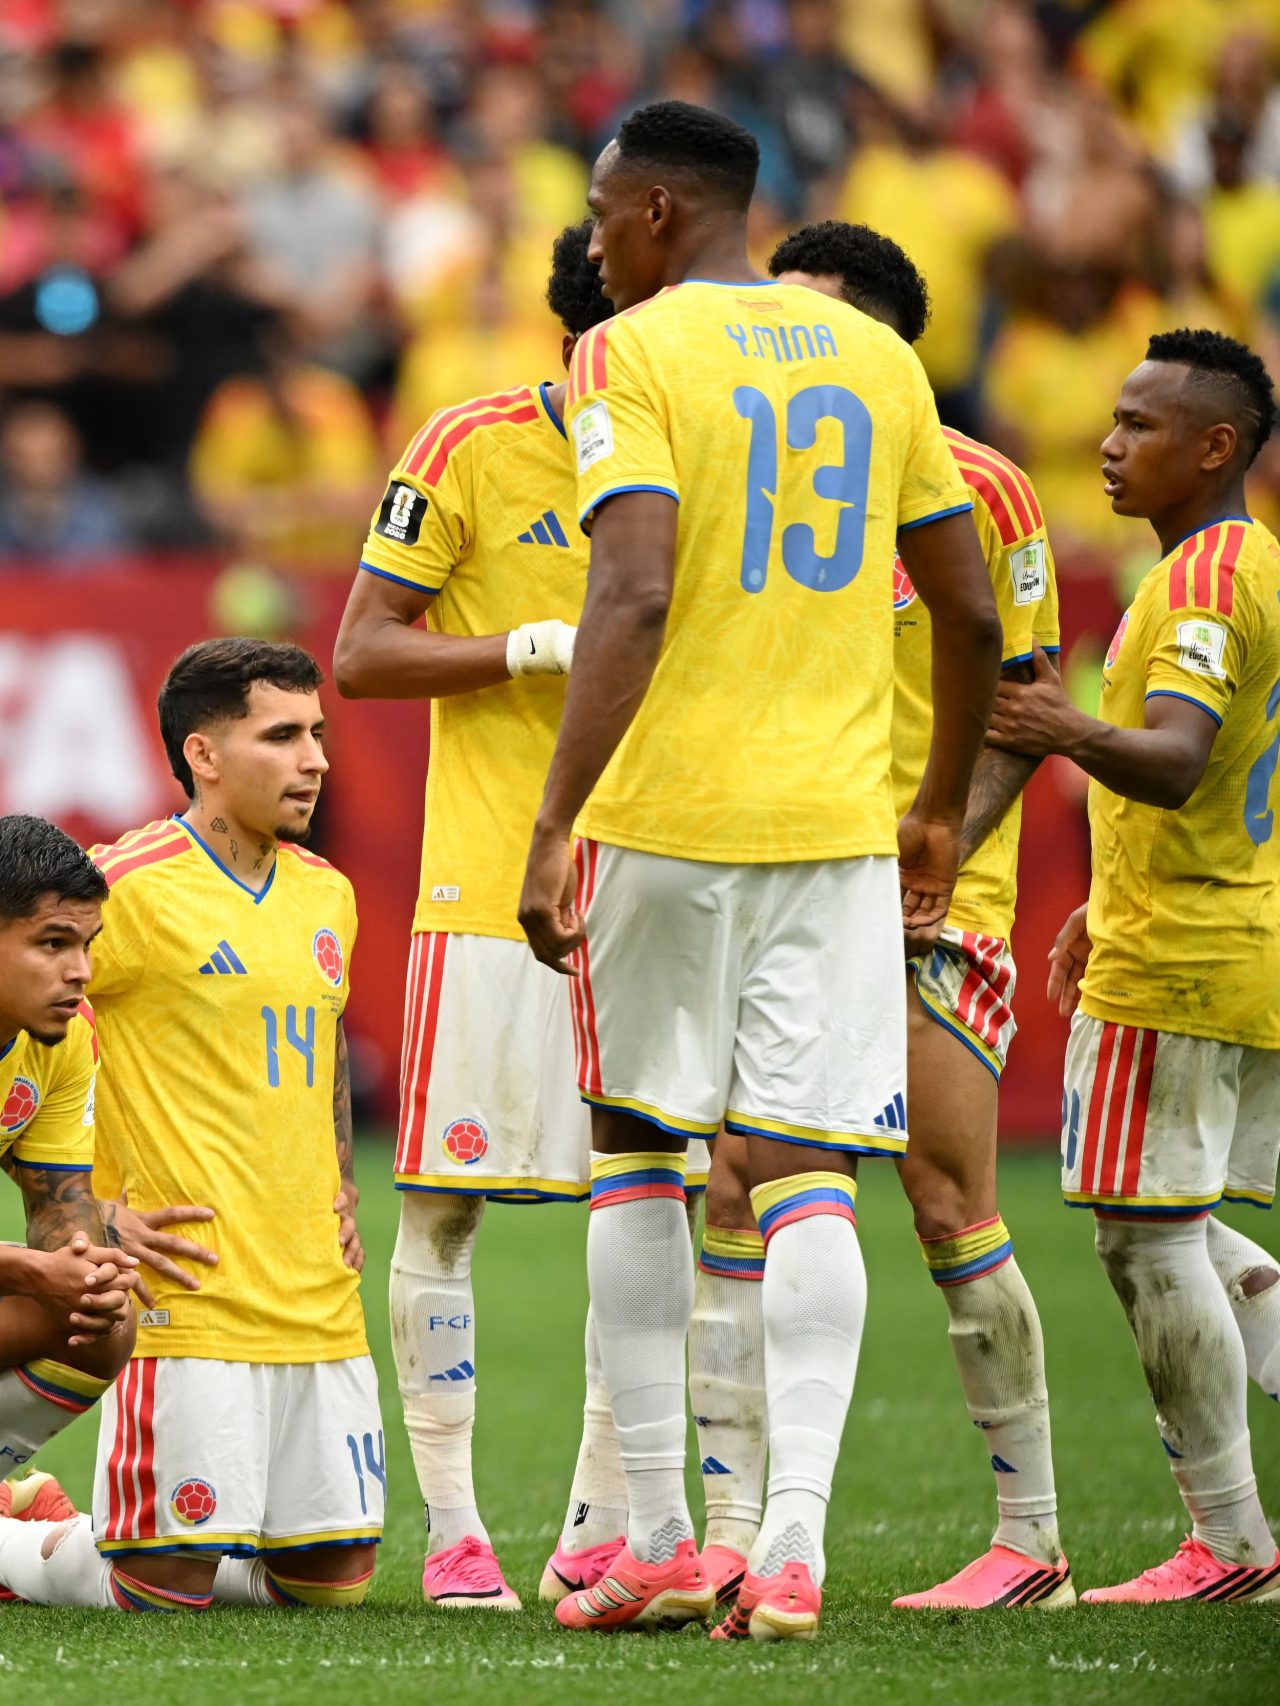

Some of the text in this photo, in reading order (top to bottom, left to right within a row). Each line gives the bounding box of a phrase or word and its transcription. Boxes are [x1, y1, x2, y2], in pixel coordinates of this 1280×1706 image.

[724, 323, 838, 363] Y.MINA
[732, 384, 873, 594] 13
[261, 1004, 316, 1088] 14
[429, 1314, 471, 1331] FCF
[0, 1445, 32, 1464] FC
[347, 1430, 387, 1515] 14
